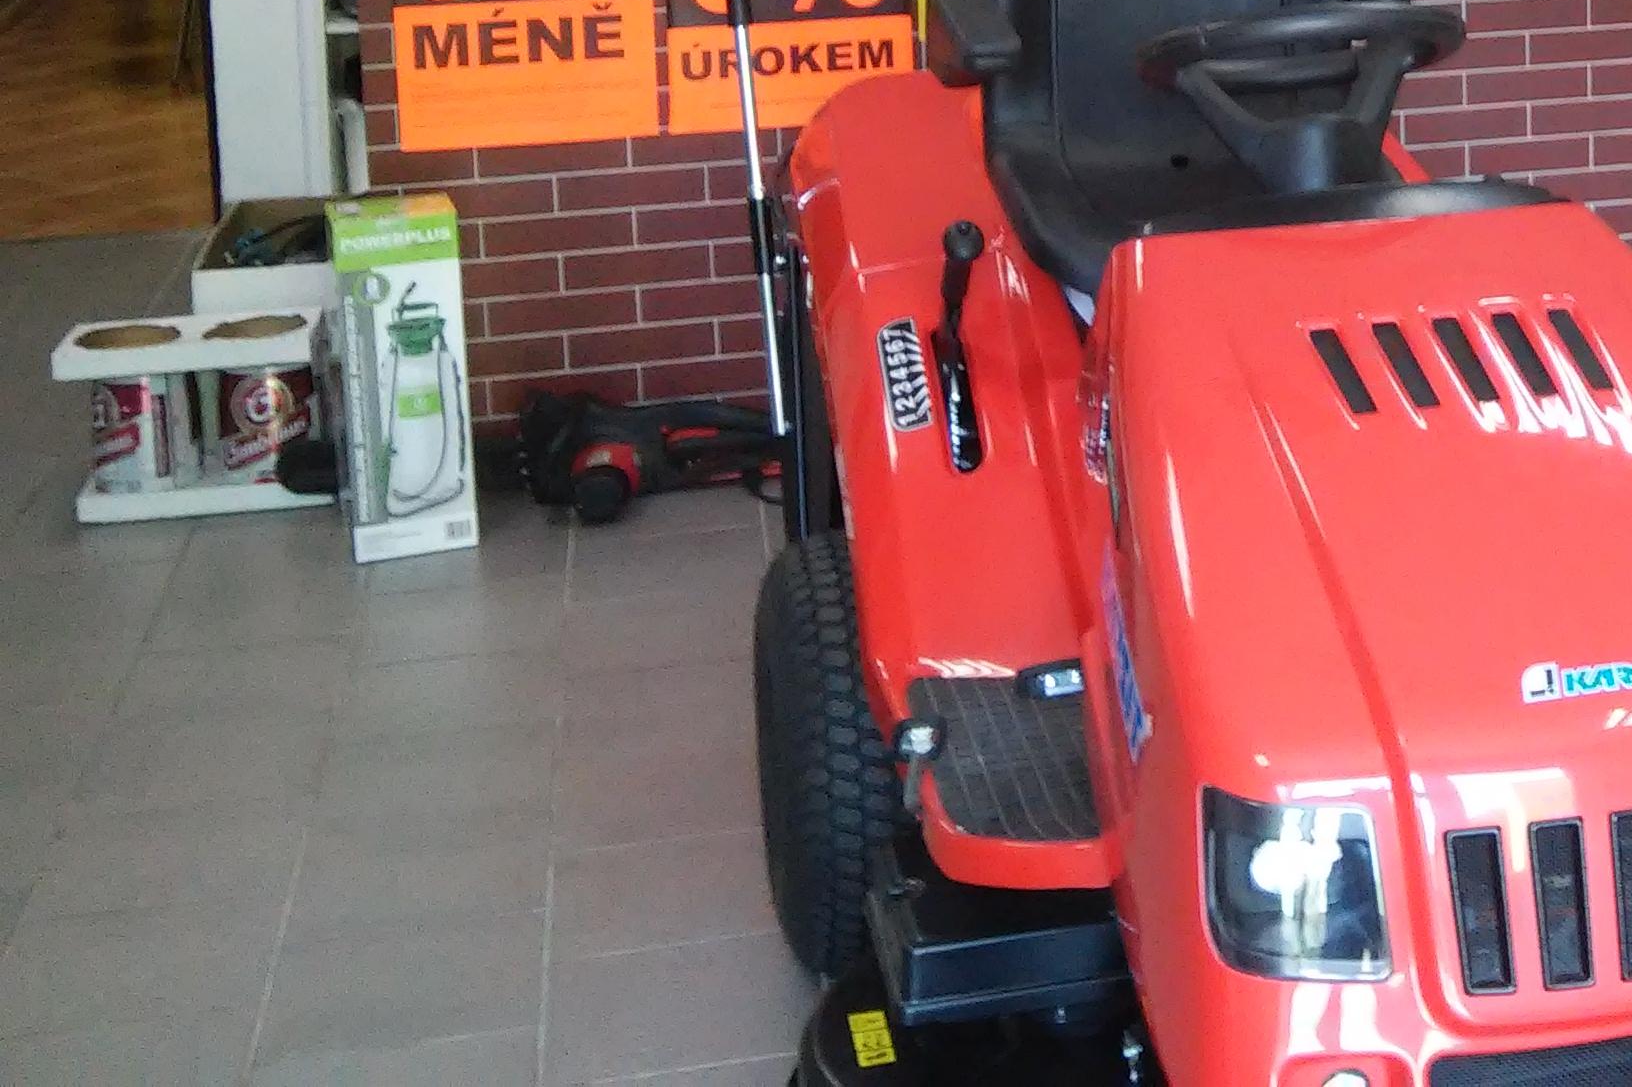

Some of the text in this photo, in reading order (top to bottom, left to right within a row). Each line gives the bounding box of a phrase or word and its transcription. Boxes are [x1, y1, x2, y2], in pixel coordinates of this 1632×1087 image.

[412, 2, 625, 70] MÉNĚ
[681, 38, 894, 80] ÚROKEM
[340, 226, 451, 254] POWERPLUS
